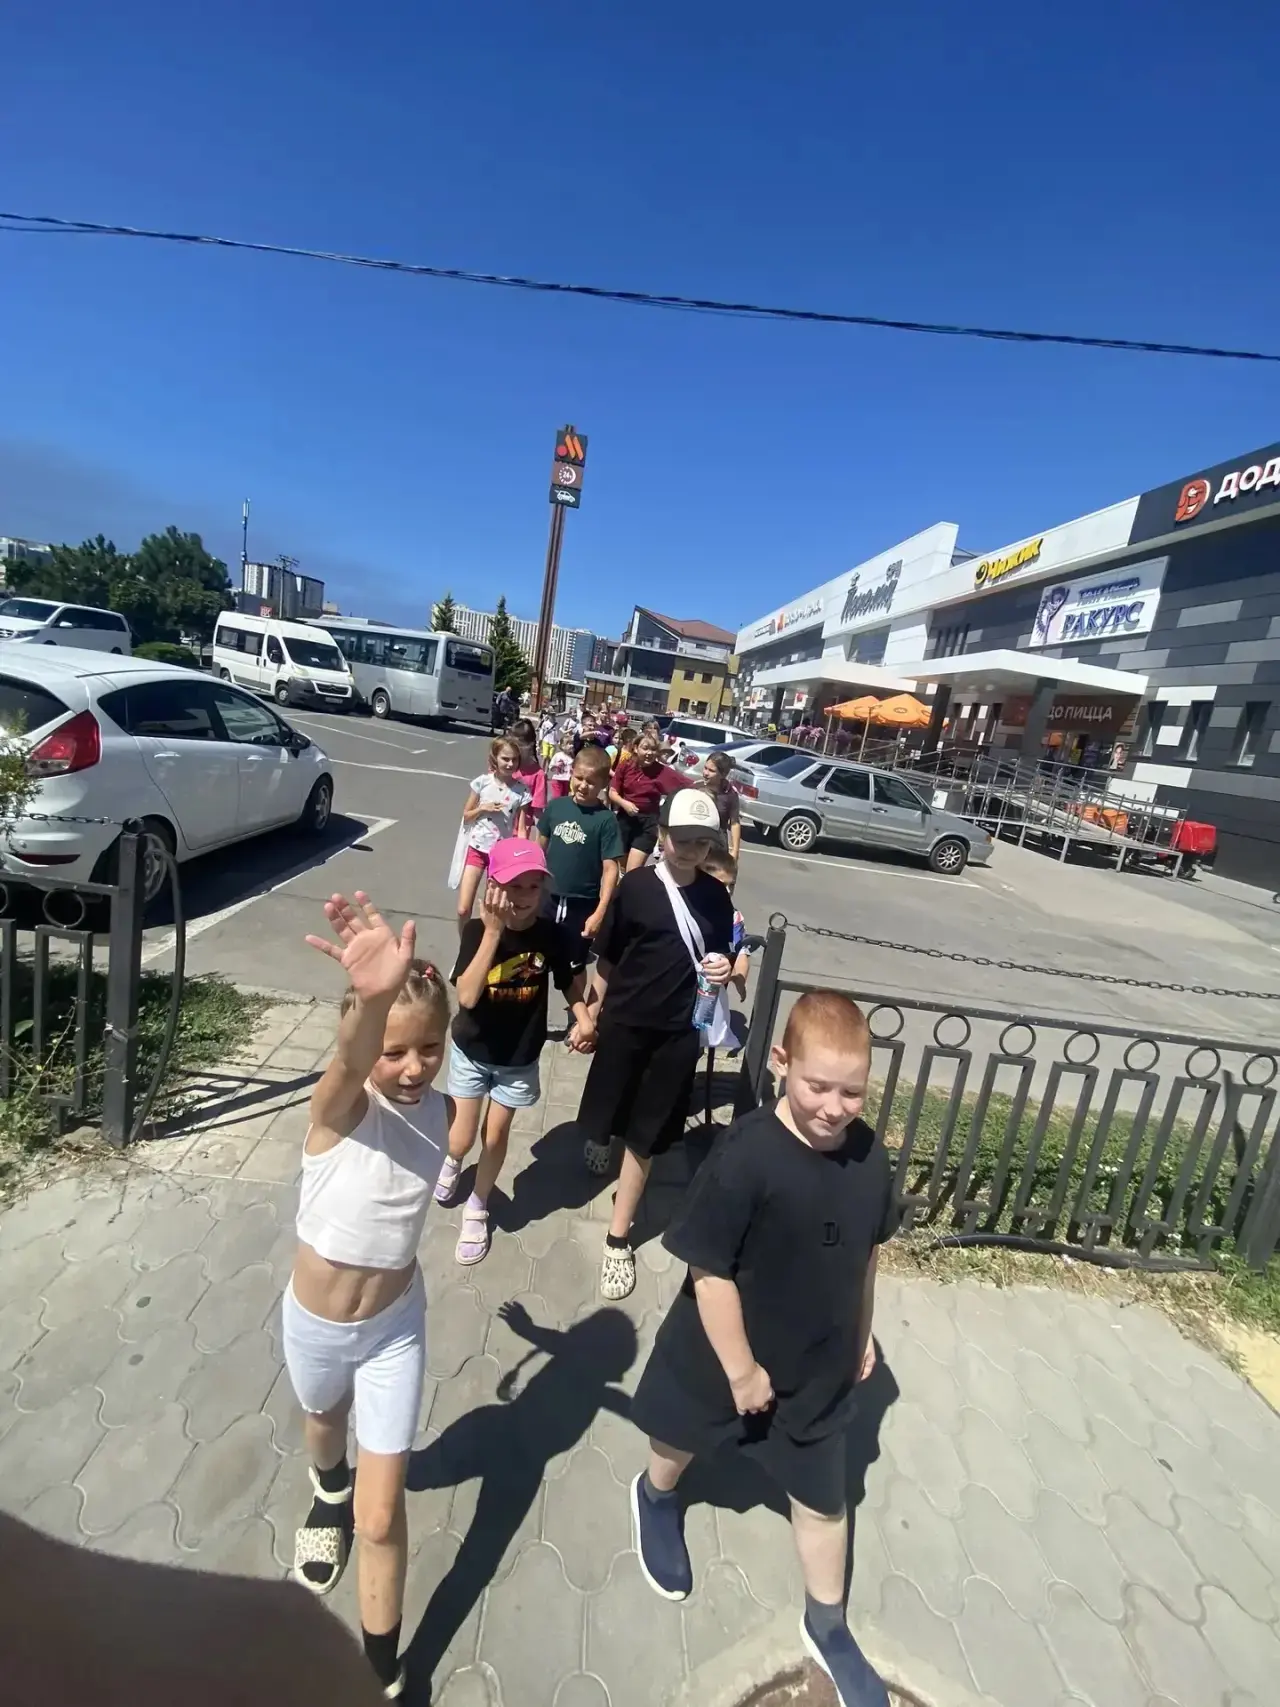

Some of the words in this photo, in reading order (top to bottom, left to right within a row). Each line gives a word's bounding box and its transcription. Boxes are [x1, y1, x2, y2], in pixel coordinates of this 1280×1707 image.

[1062, 601, 1146, 633] РАКУРС
[1064, 706, 1112, 721] ПИЦЦА
[553, 824, 587, 844] ADVENTURE
